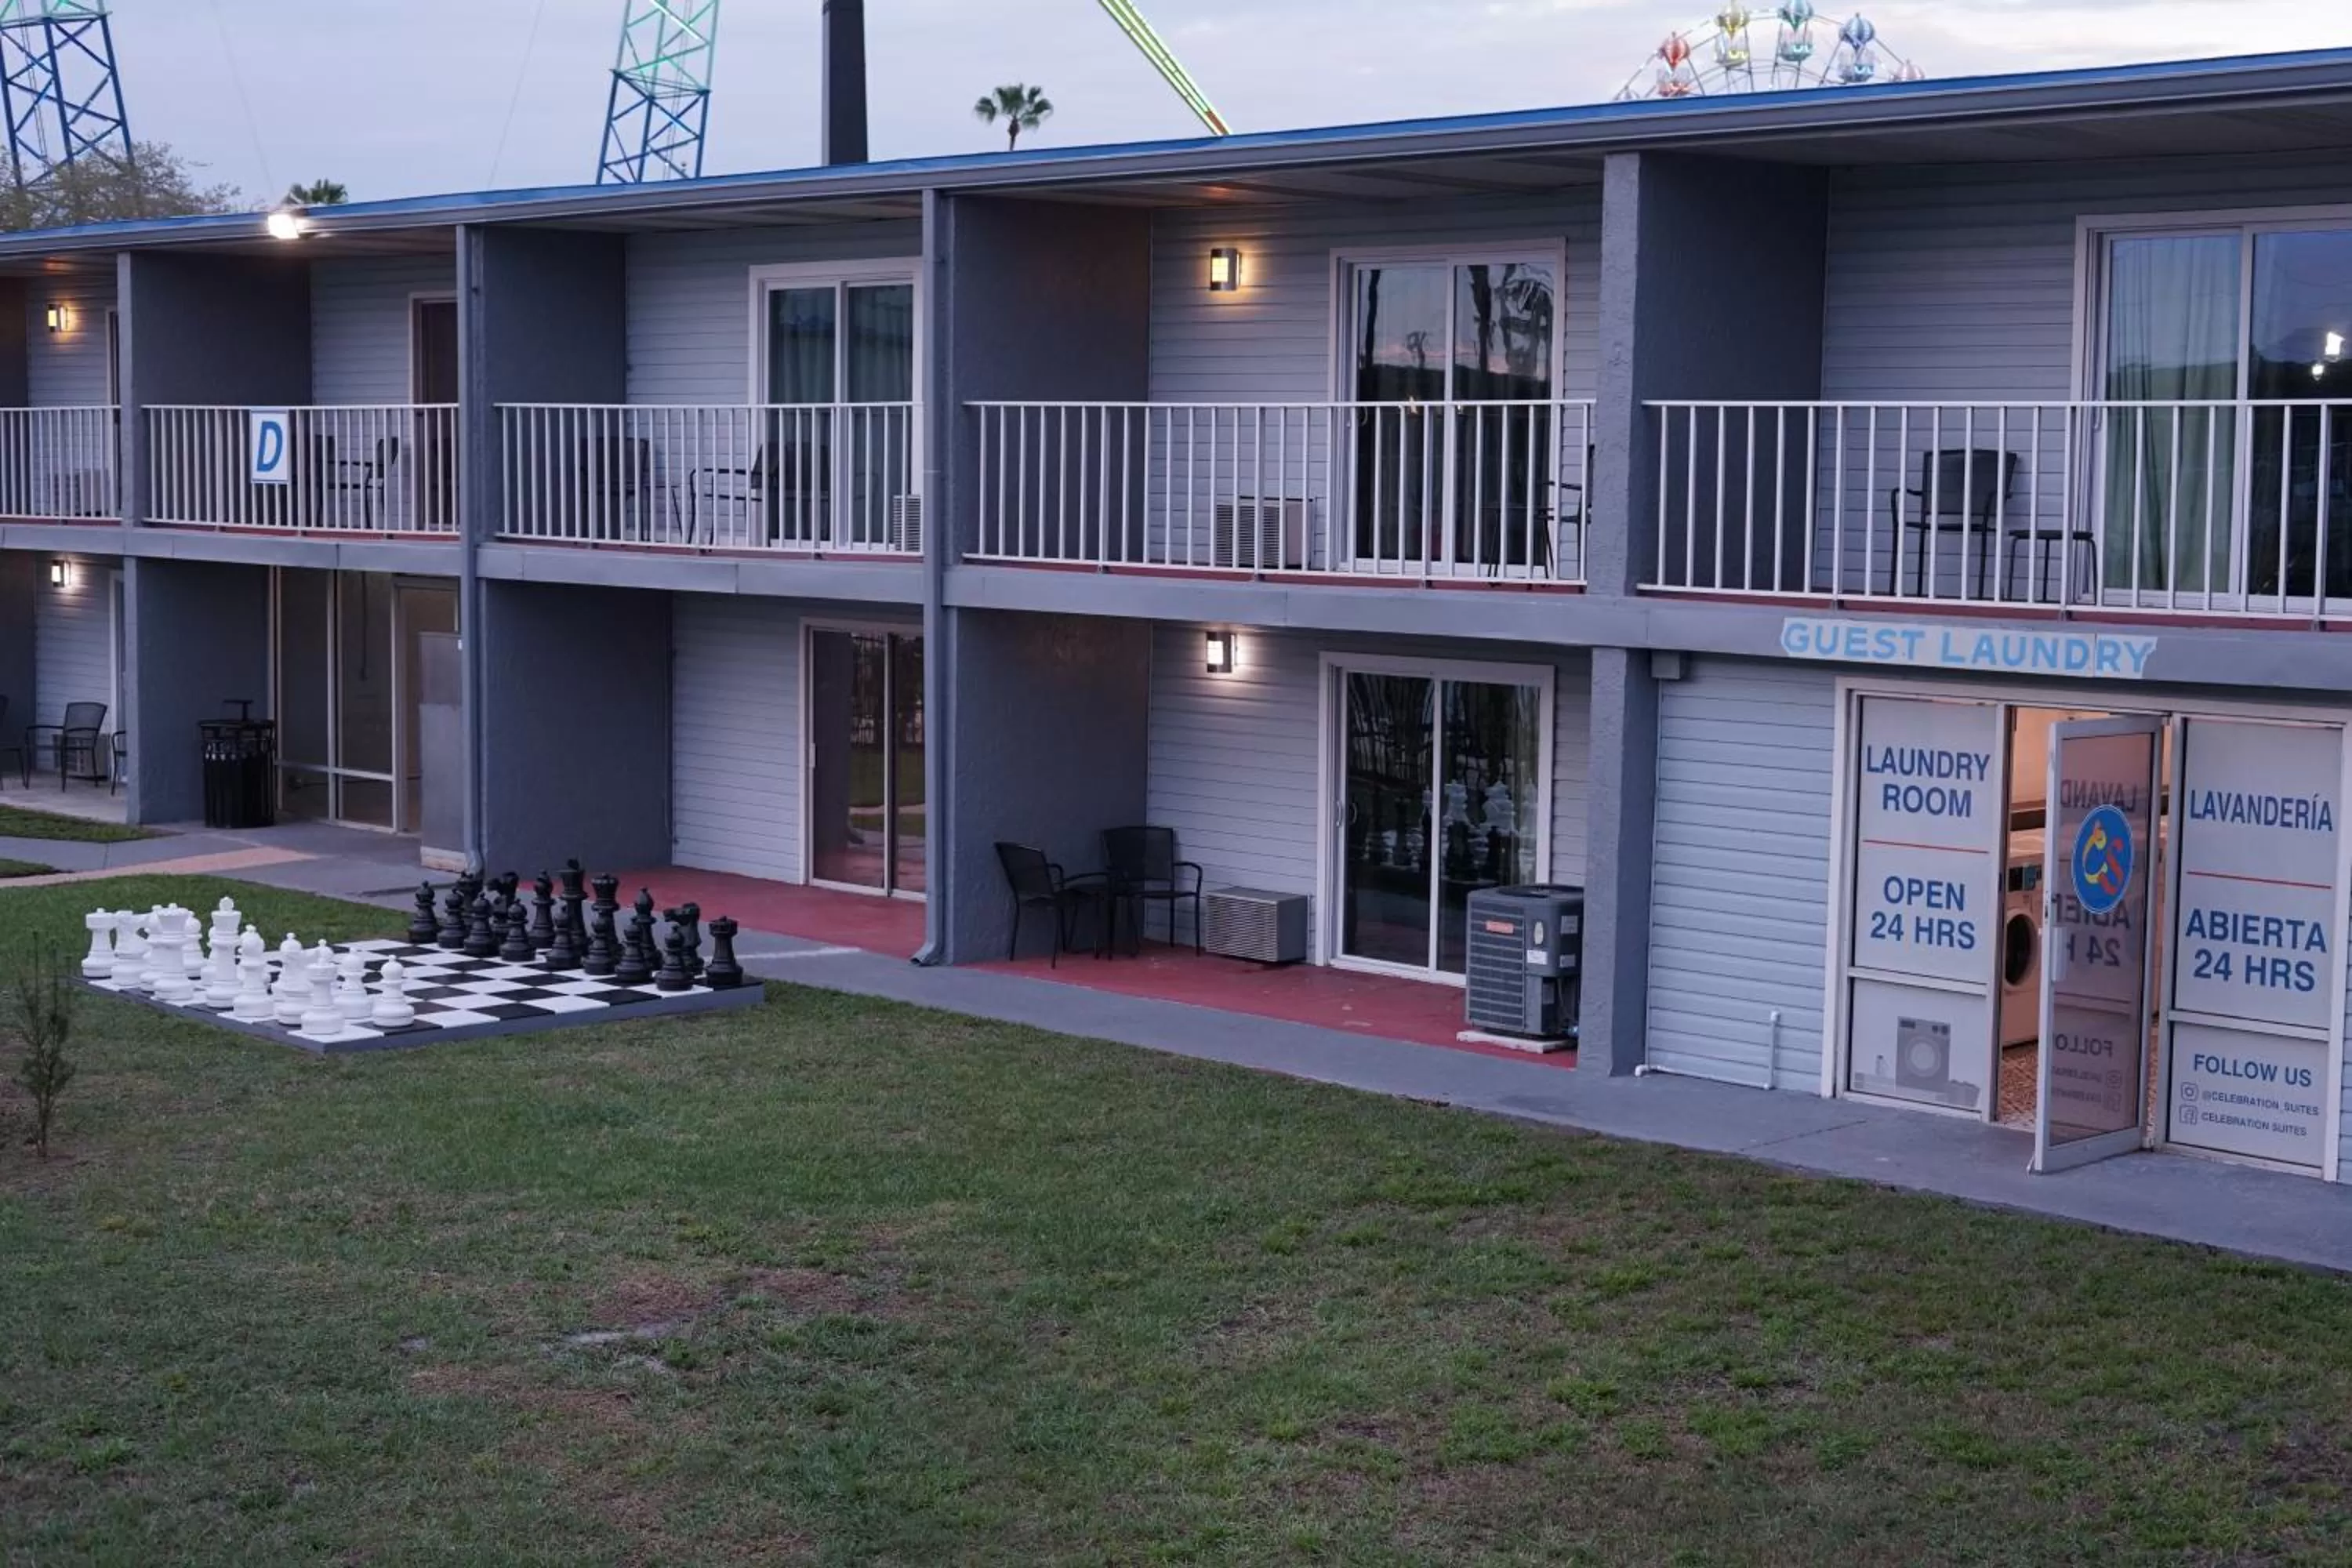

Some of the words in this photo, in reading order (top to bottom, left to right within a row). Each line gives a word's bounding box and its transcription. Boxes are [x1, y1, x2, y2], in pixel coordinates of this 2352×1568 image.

[256, 421, 283, 472] D
[1784, 622, 1926, 660] GUEST
[1941, 631, 2153, 673] LAUNDRY
[1866, 746, 1991, 782] LAUNDRY
[1882, 783, 1972, 818] ROOM
[2190, 789, 2333, 832] LAVANDERÍA
[1883, 876, 1965, 912] OPEN
[1870, 911, 1904, 942] 24
[1915, 916, 1976, 950] HRS
[2186, 908, 2327, 954] ABIERTA
[2194, 949, 2233, 982] 24
[2245, 955, 2315, 992] HRS
[2193, 1053, 2278, 1083] FOLLOW
[2285, 1066, 2312, 1087] US
[2201, 1112, 2270, 1130] CELEBRATION
[2272, 1123, 2307, 1137] SUITES
